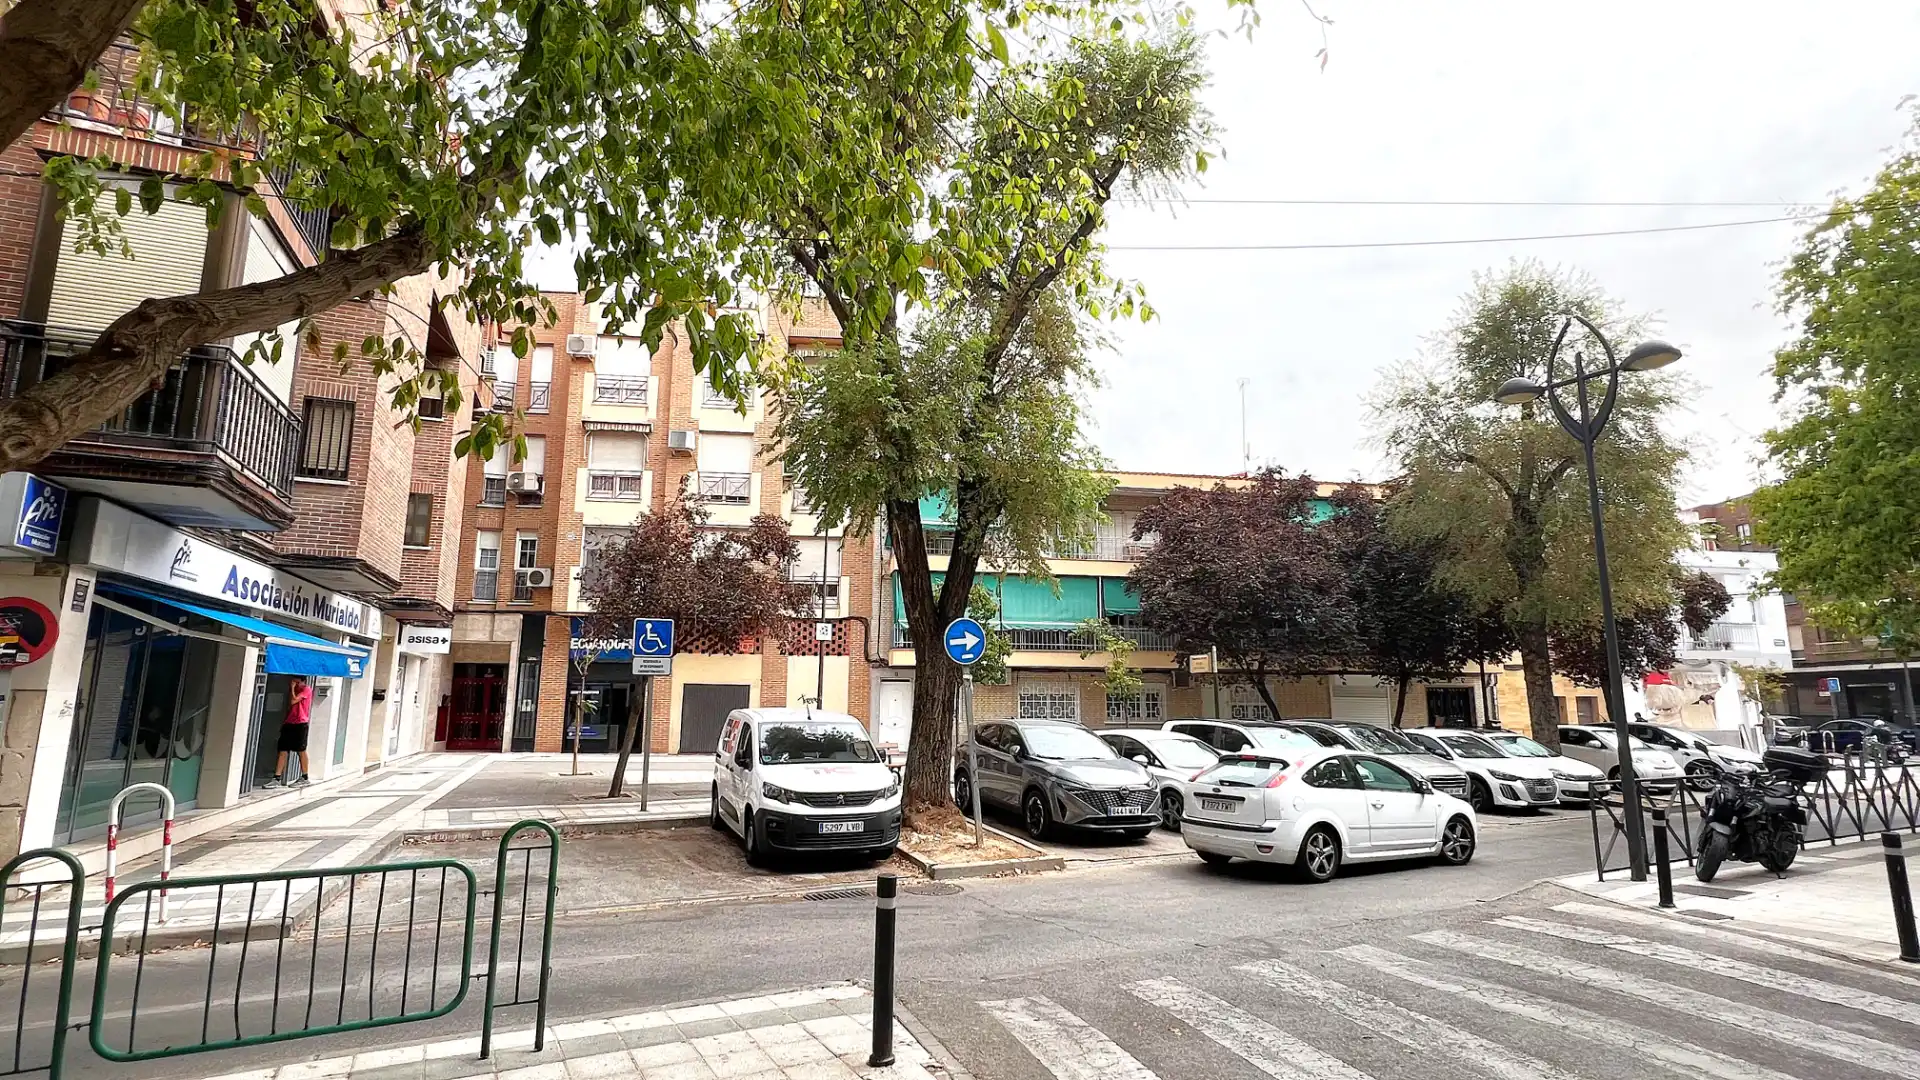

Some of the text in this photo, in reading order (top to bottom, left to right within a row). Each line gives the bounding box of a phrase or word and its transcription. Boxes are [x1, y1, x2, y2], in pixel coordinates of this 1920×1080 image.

[221, 564, 360, 630] Asociación Murialdo
[407, 635, 440, 645] asisa
[824, 823, 844, 832] 5297
